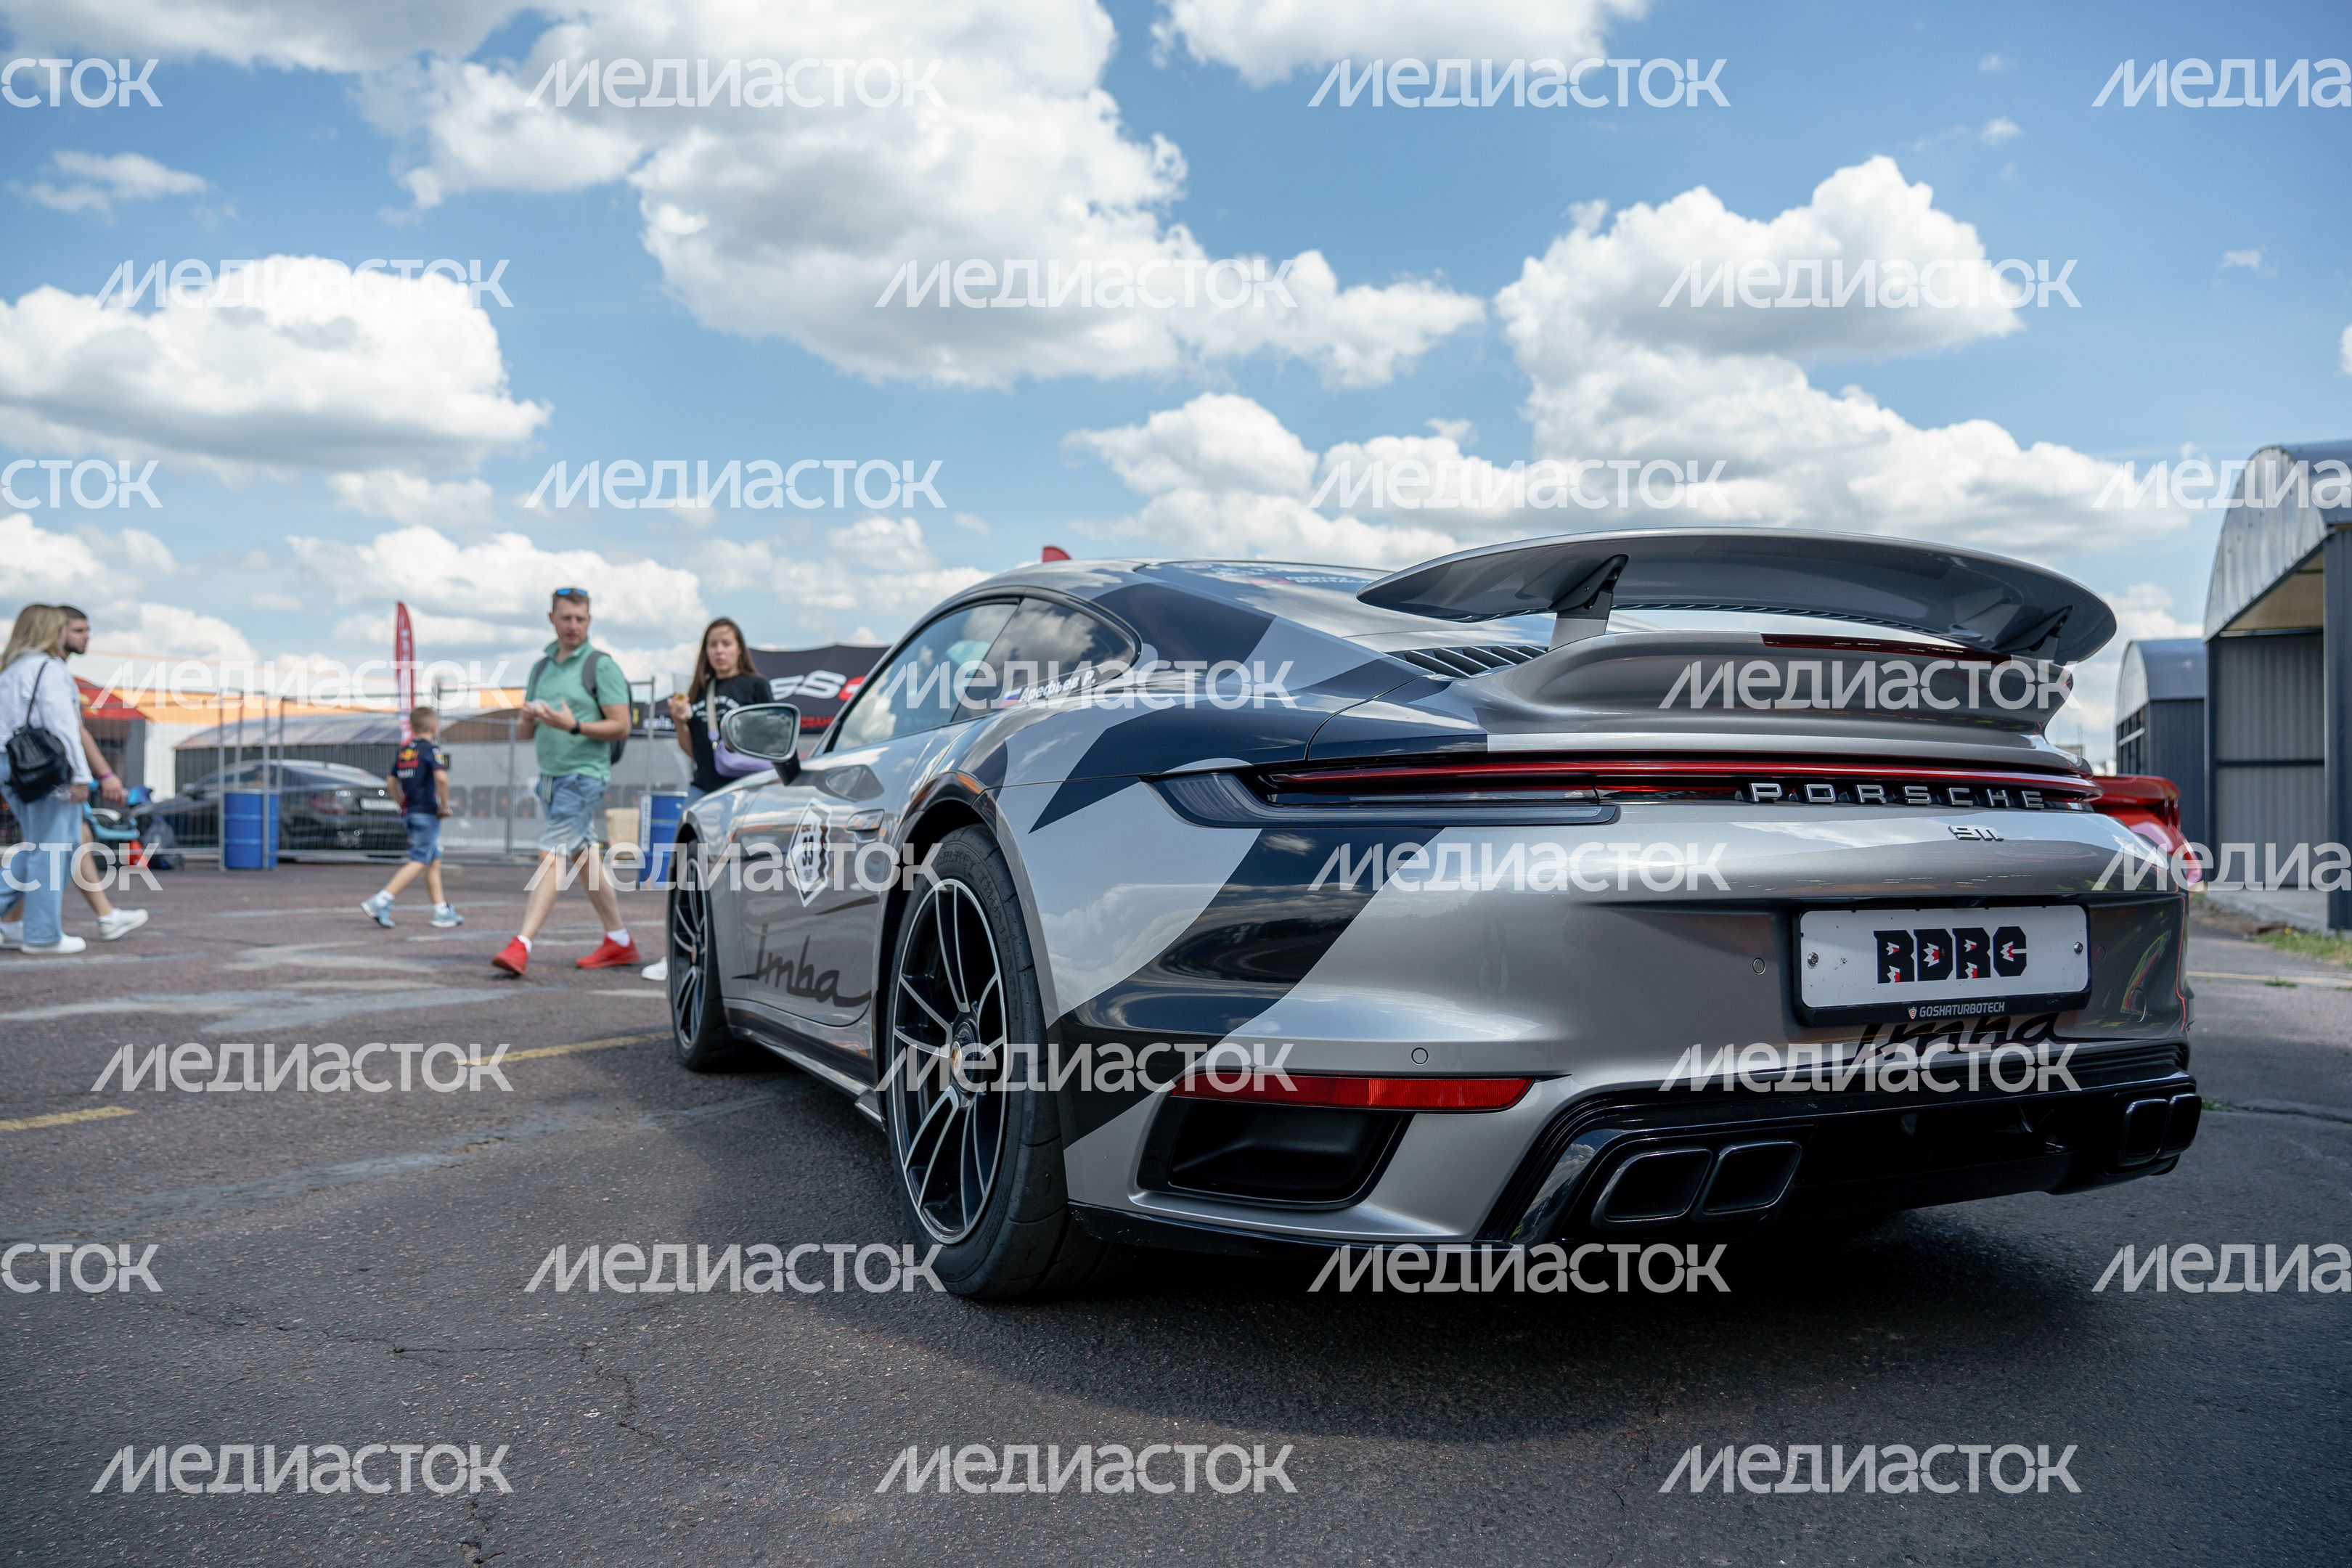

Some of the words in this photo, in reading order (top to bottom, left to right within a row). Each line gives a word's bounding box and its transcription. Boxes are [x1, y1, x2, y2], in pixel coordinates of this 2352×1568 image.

[1019, 677, 1080, 703] Арефьев
[1748, 783, 2046, 810] PORSCHE
[1948, 825, 2004, 842] 911
[1873, 926, 2028, 984] RDRC
[1919, 1001, 2005, 1018] GOSHATURBOTECH
